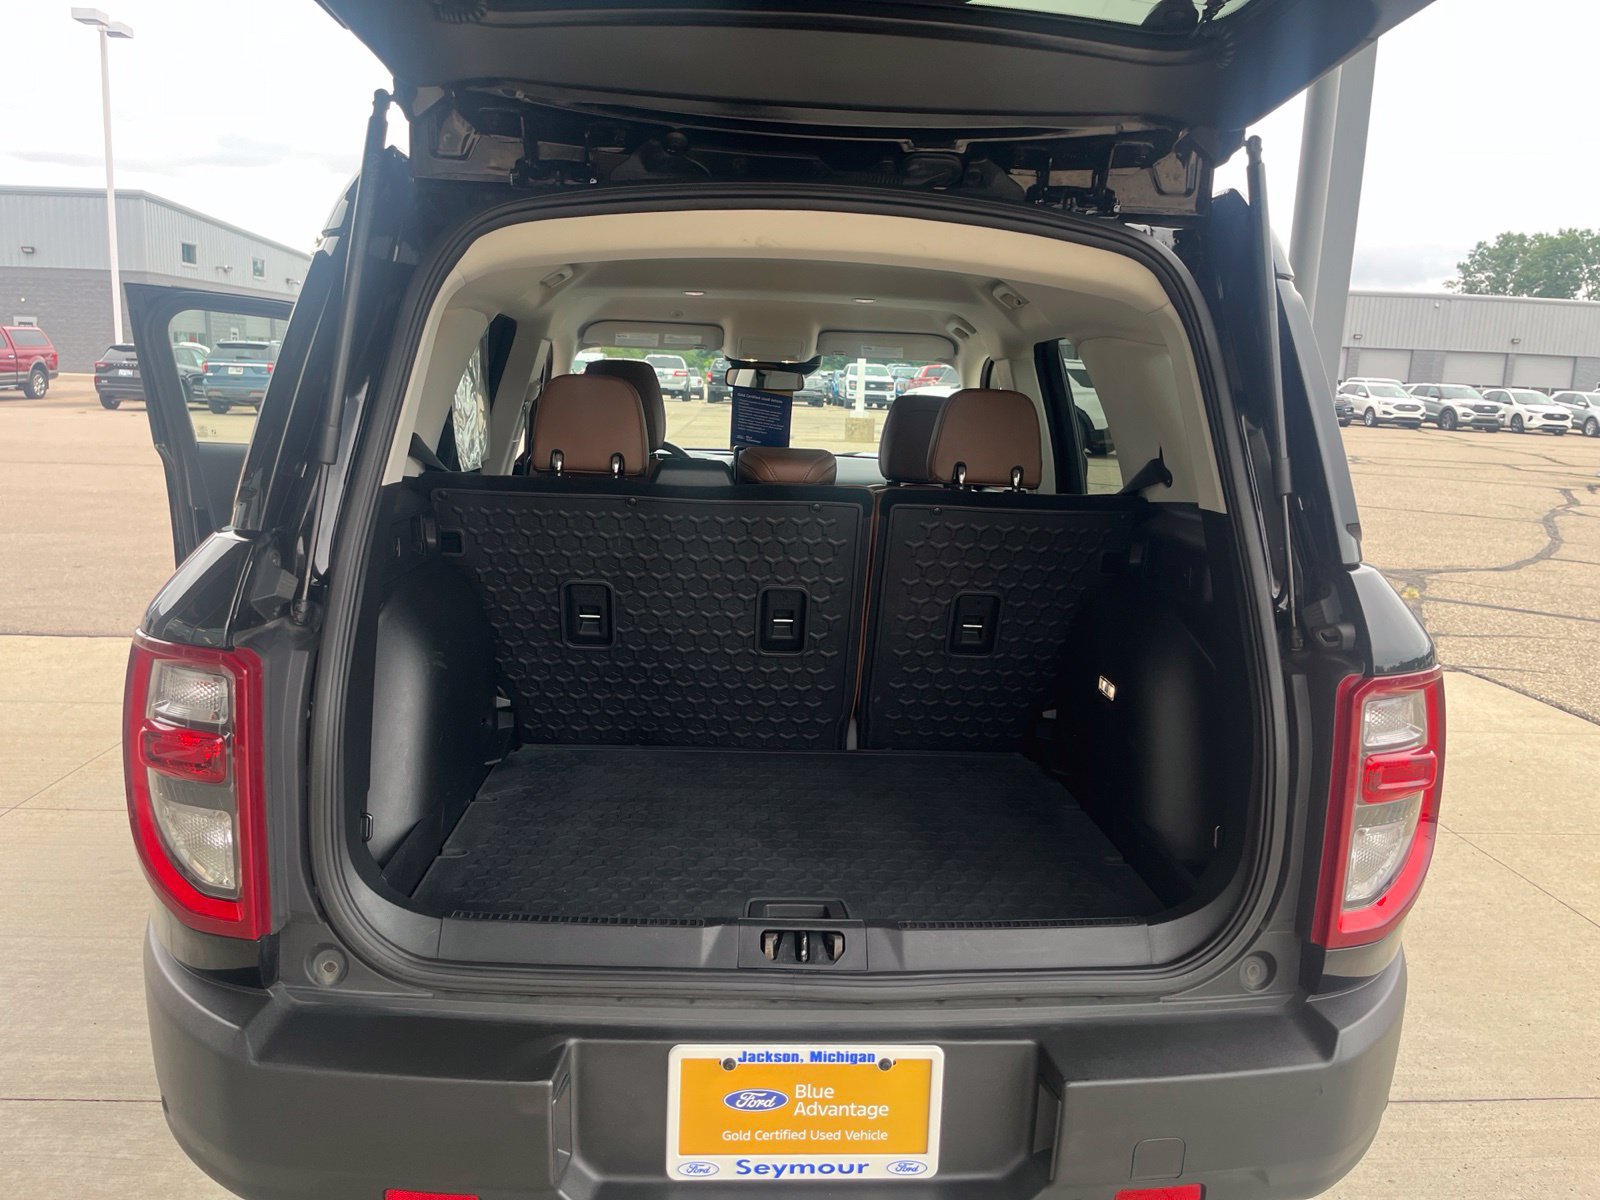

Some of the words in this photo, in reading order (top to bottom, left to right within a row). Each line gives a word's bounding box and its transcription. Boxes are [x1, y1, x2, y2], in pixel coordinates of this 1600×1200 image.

[737, 1050, 804, 1064] Jackson,
[809, 1050, 876, 1065] Michigan
[795, 1084, 835, 1099] Blue
[735, 1092, 777, 1108] Ford
[793, 1101, 890, 1120] Advantage
[721, 1129, 751, 1141] Gold
[754, 1128, 807, 1141] Certified
[809, 1129, 842, 1141] Used
[844, 1129, 889, 1141] Vehicle
[735, 1158, 870, 1179] Seymour
